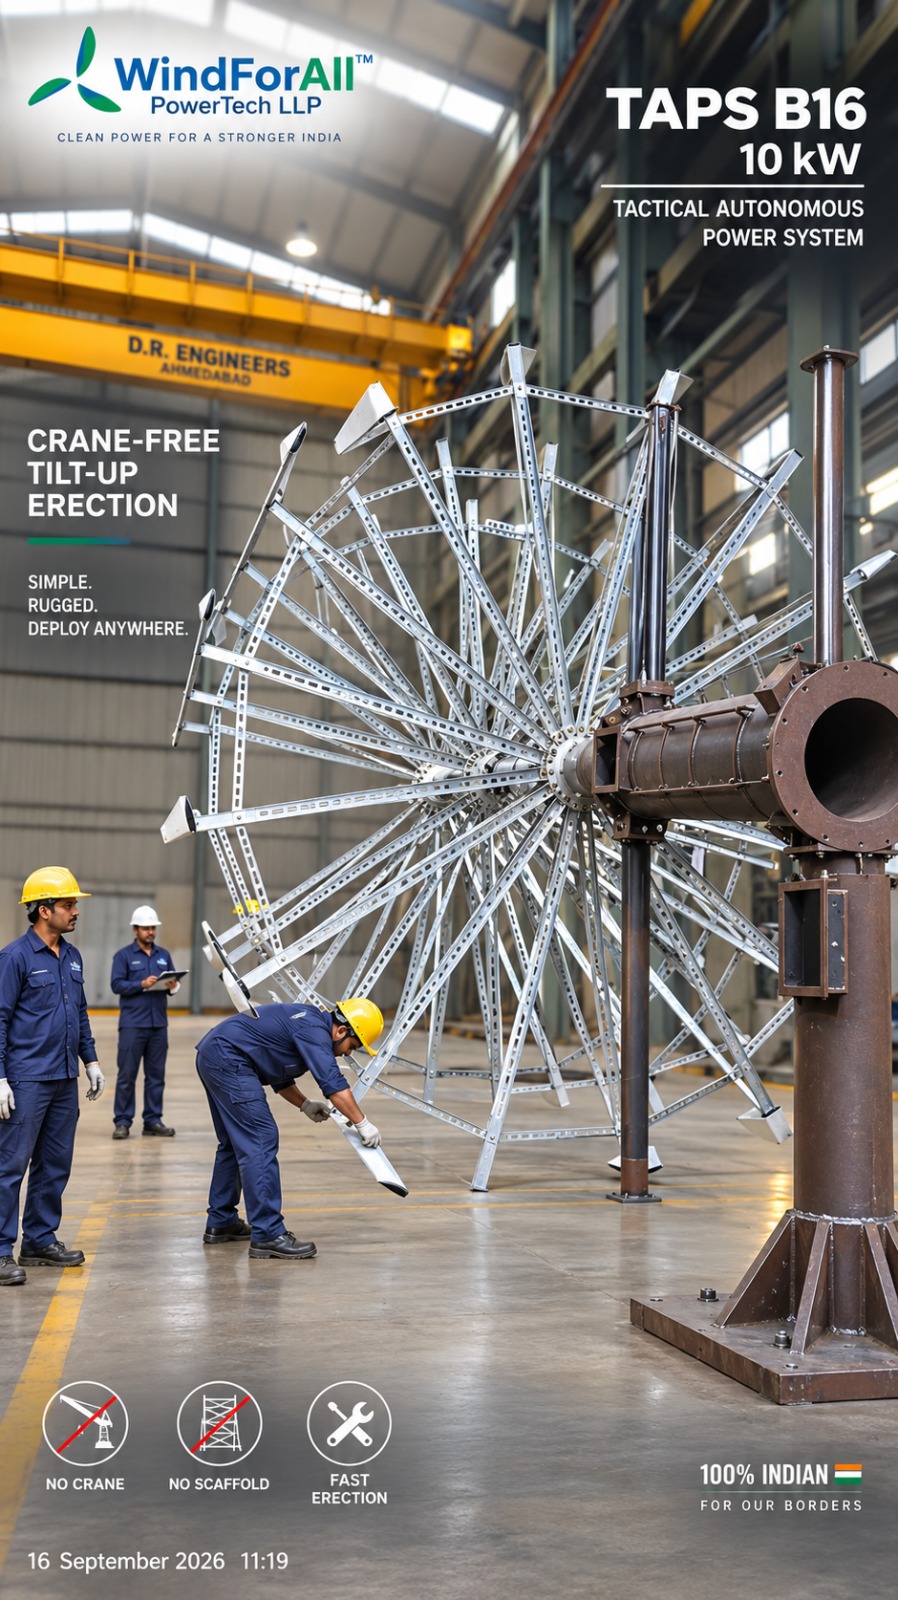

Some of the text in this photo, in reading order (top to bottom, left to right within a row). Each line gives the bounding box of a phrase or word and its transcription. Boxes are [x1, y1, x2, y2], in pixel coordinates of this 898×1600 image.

[128, 336, 291, 377] D.R. ENGINEERS
[160, 362, 252, 386] AHMEDABAD
